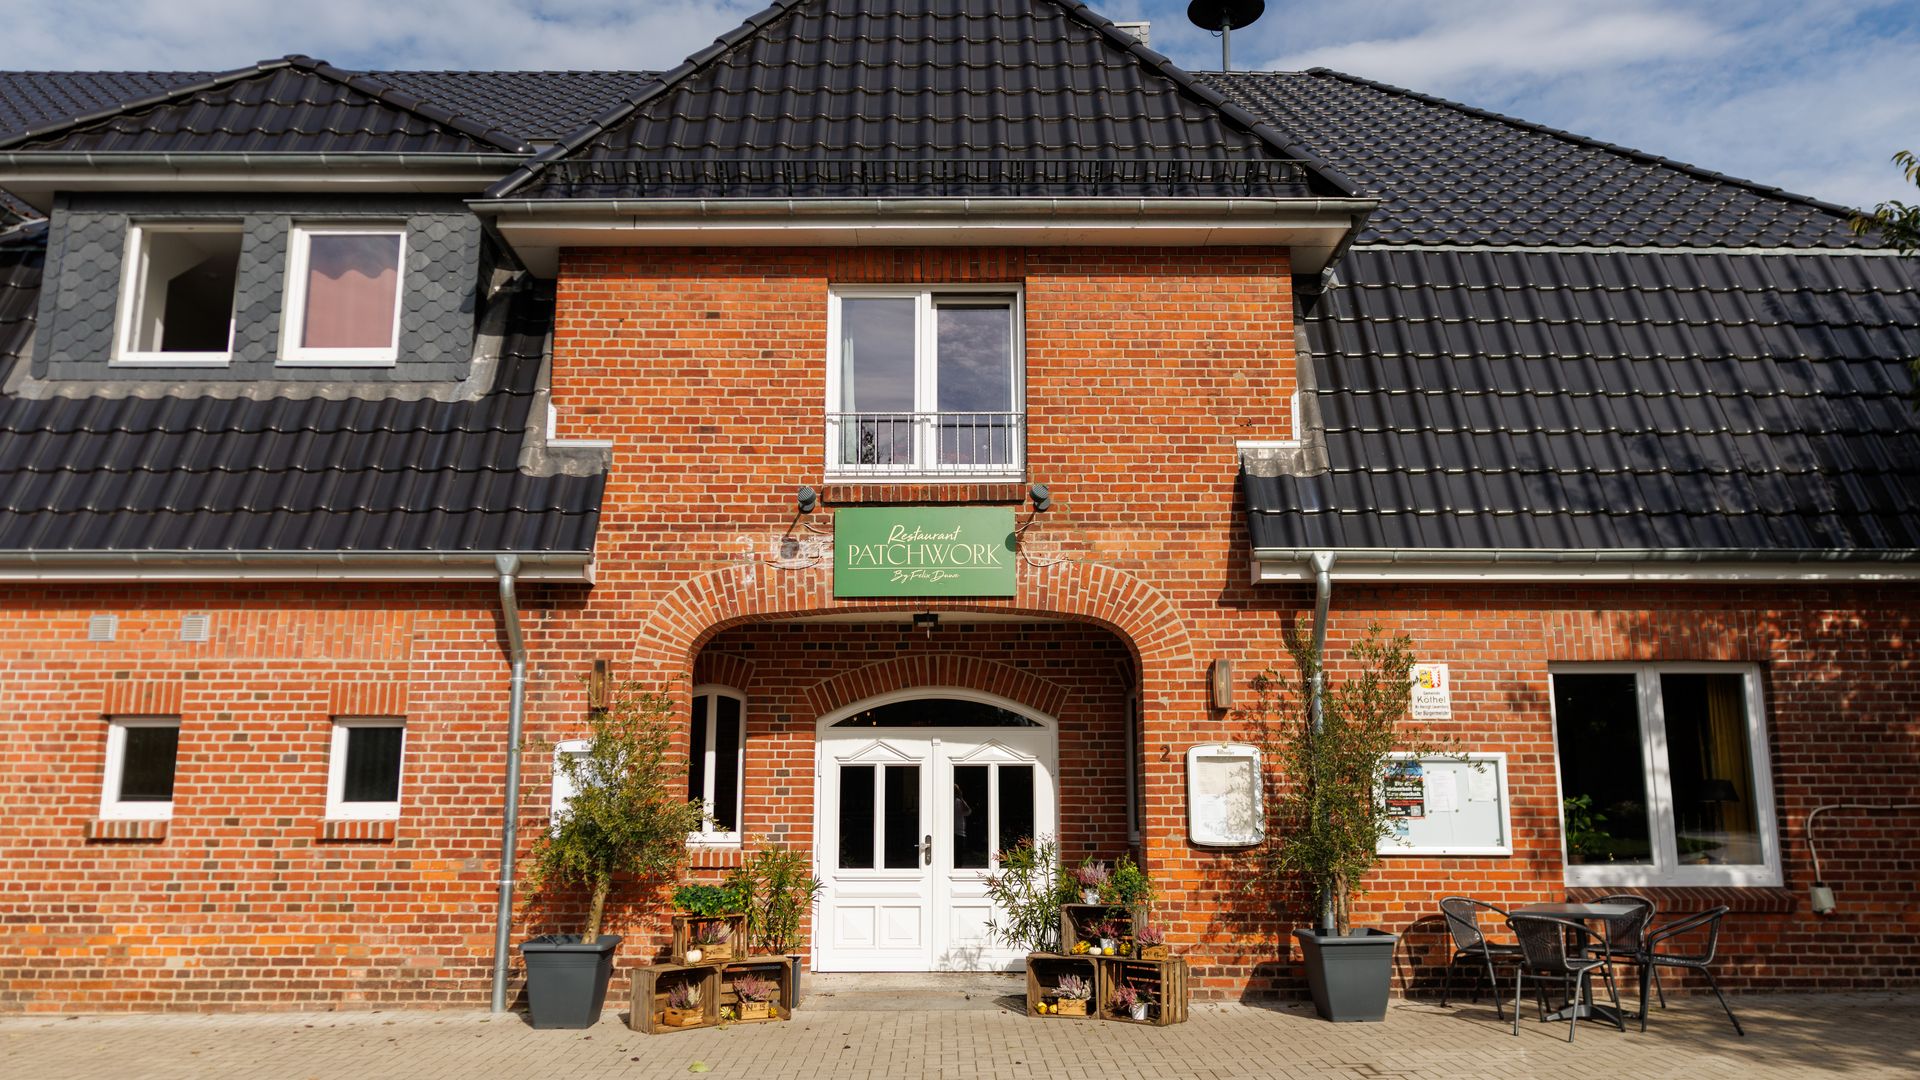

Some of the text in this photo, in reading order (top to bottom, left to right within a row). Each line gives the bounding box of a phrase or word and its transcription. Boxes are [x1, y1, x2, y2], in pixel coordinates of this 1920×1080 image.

[888, 524, 962, 544] Restaurant
[848, 543, 1002, 565] PATCHWORK
[890, 569, 909, 584] By
[910, 569, 931, 581] Felix
[1417, 695, 1446, 704] Köthel
[1160, 745, 1170, 762] 2
